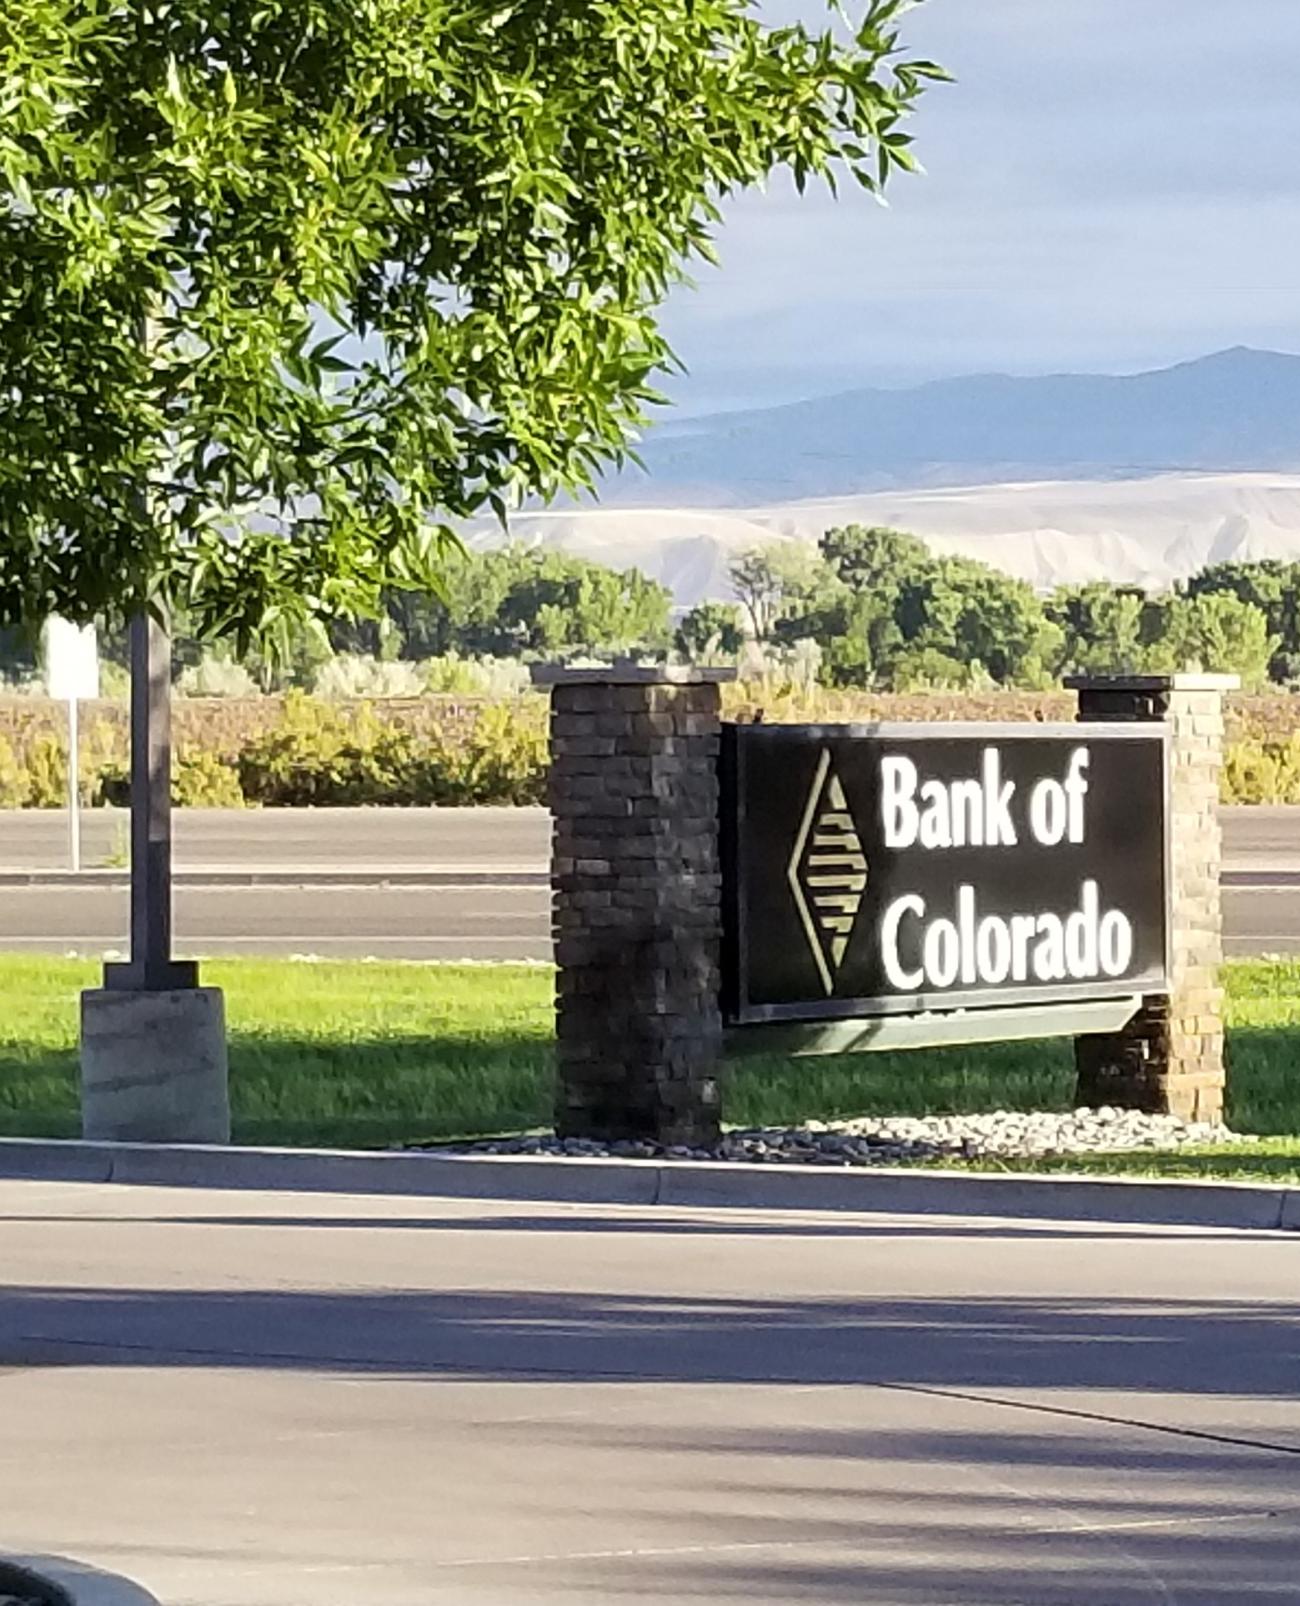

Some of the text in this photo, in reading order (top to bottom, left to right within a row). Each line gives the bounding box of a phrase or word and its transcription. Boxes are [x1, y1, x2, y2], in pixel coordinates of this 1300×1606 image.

[880, 747, 1090, 850] Bank of
[880, 880, 1133, 990] Colorado
